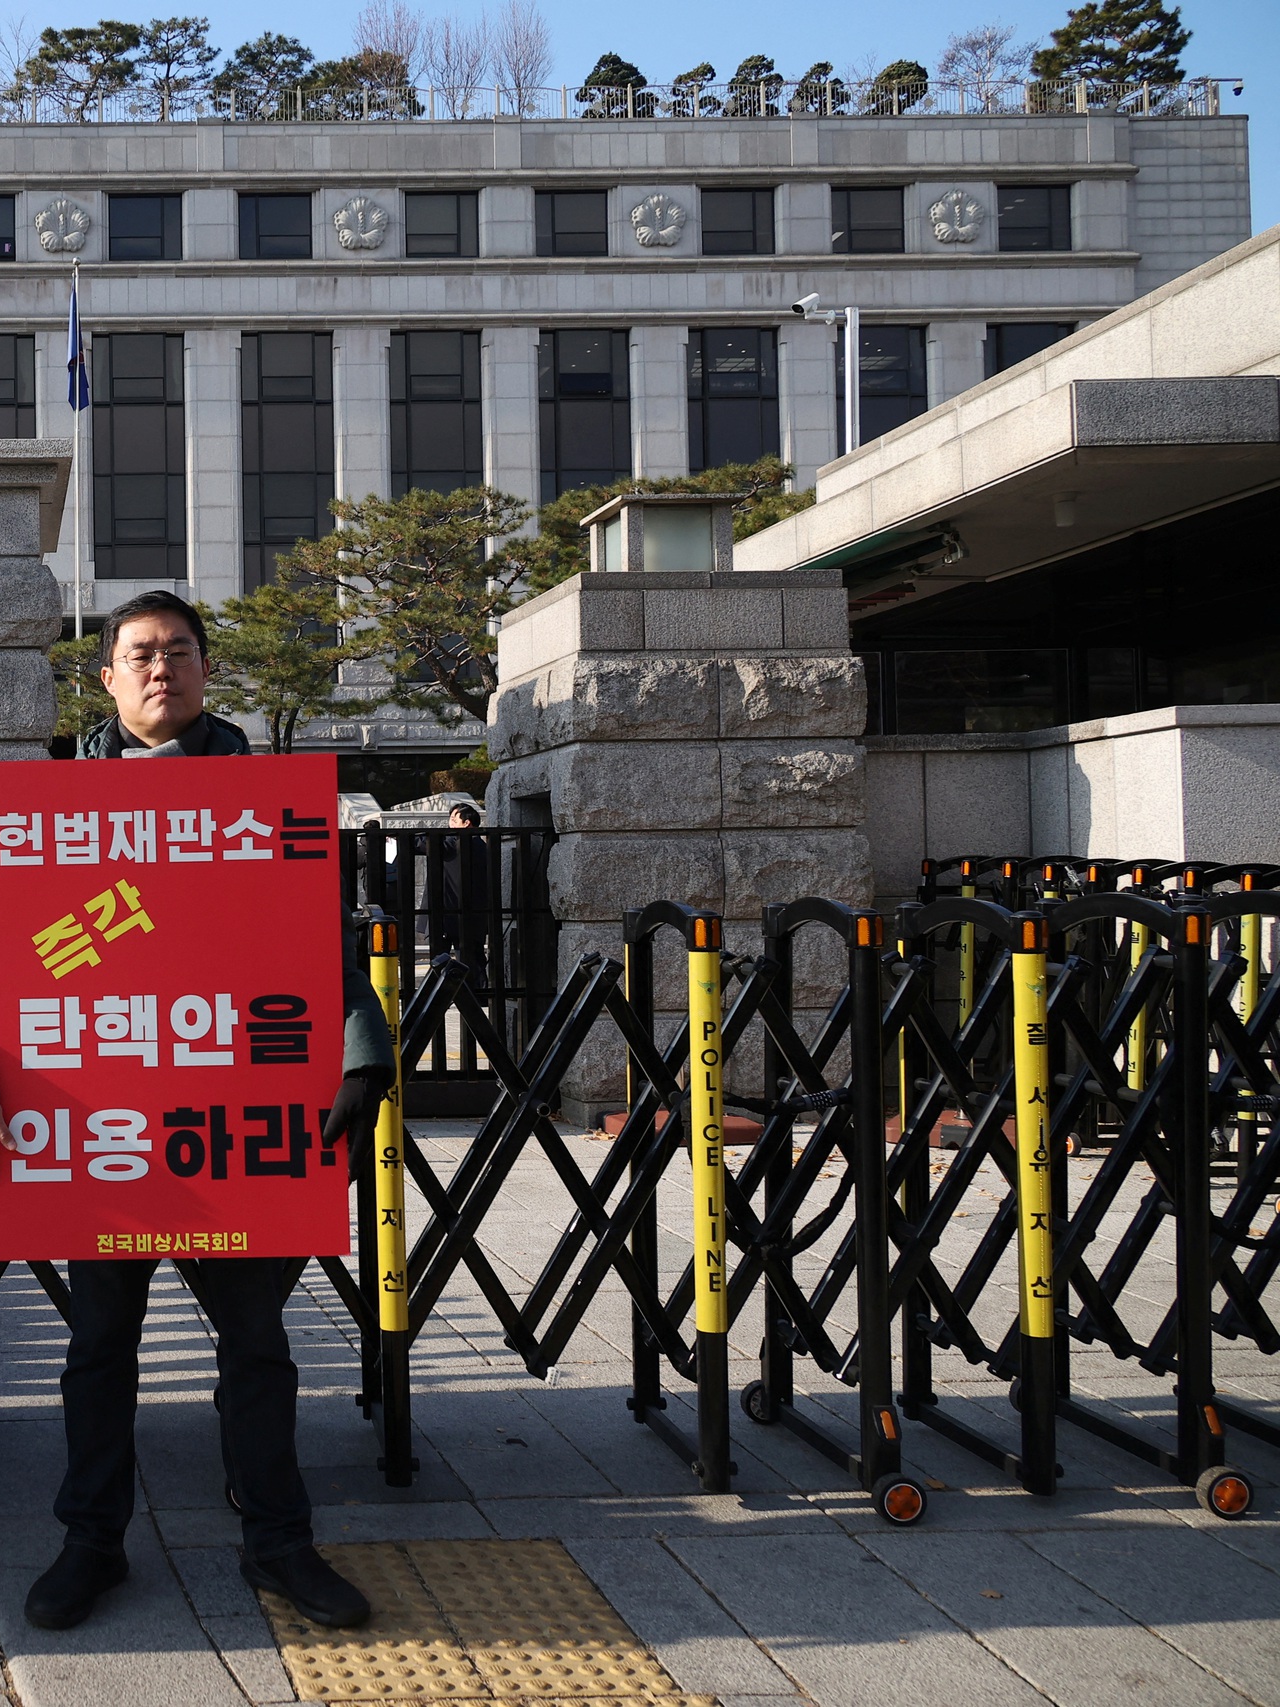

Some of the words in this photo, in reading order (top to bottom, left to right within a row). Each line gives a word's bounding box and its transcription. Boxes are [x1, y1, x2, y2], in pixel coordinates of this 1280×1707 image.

[31, 878, 155, 980] 즉각
[18, 994, 312, 1070] 탄핵안을
[701, 1021, 720, 1167] POLICE
[8, 1103, 336, 1183] 인용하라!
[1026, 1022, 1053, 1299] 질서유지선
[96, 1231, 248, 1253] 전국비상시국회의
[706, 1196, 722, 1293] LINE
